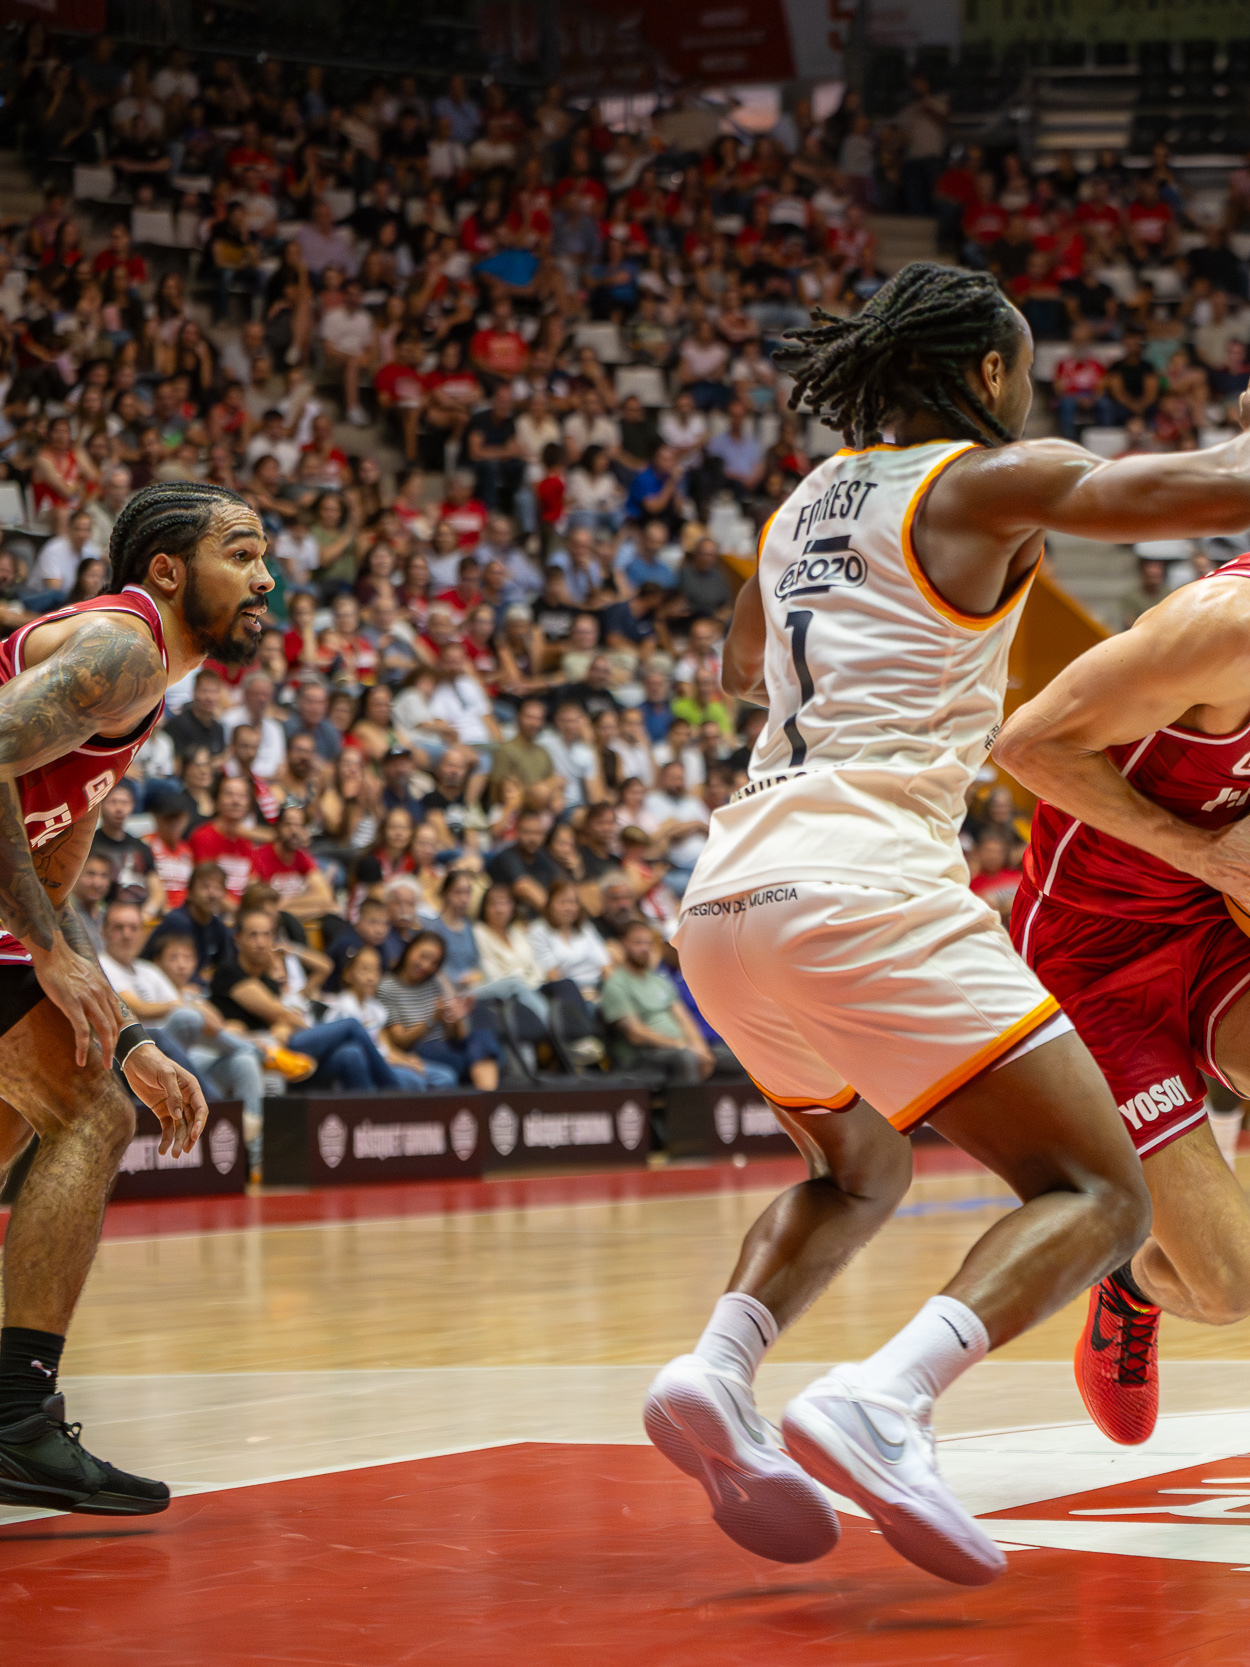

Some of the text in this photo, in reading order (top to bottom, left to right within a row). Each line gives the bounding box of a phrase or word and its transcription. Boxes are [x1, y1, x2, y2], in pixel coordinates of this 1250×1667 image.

[783, 611, 814, 767] 1
[749, 888, 798, 908] MURCIA
[1118, 1075, 1192, 1130] YOSOY
